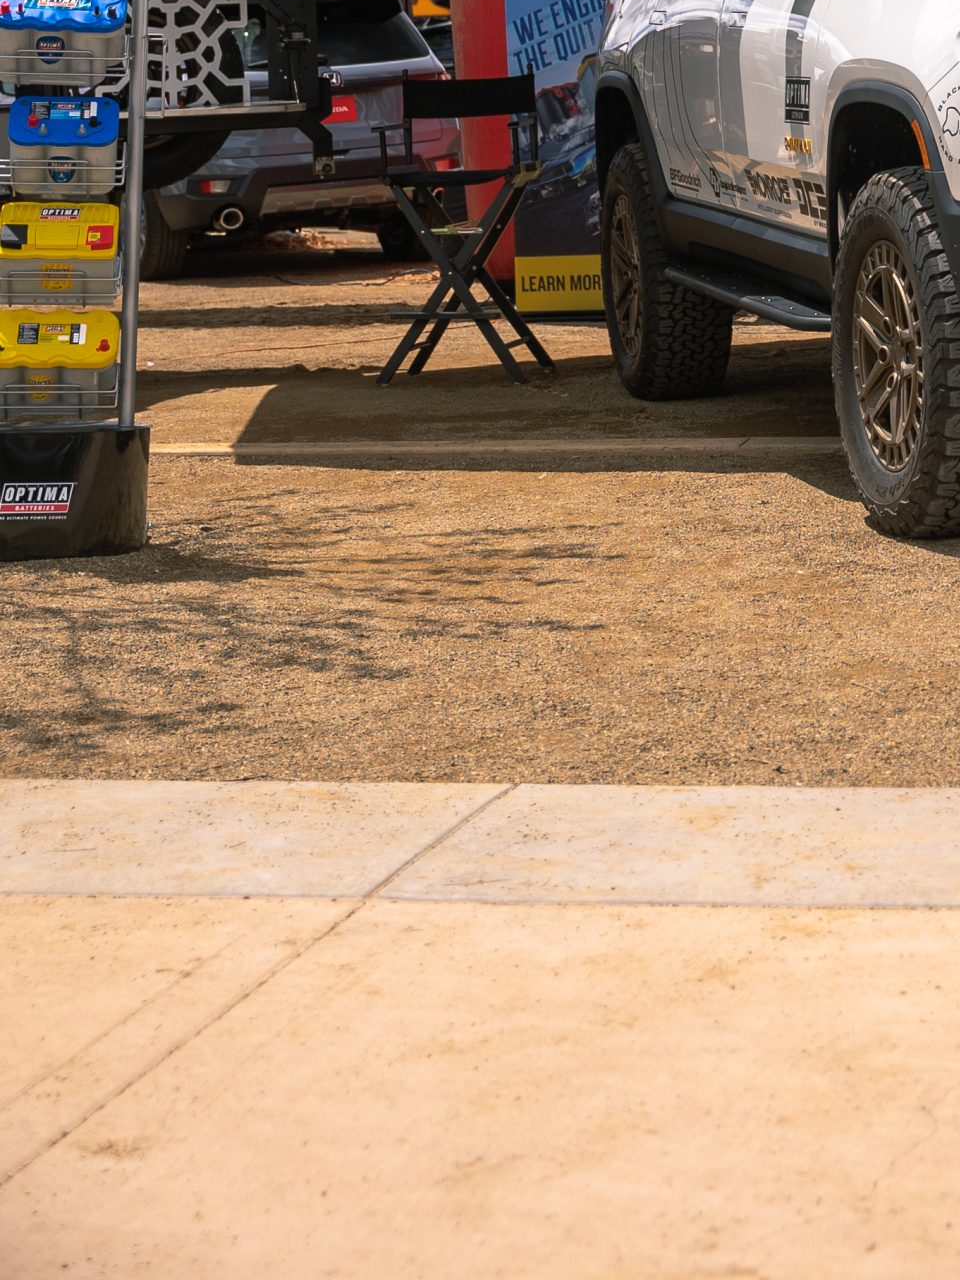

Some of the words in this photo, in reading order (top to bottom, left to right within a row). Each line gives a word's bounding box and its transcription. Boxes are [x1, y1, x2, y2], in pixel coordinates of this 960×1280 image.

[513, 8, 548, 45] WE
[513, 40, 552, 75] THE
[553, 19, 596, 61] QUIT
[938, 135, 953, 162] HARD
[521, 275, 567, 292] LEARN
[570, 274, 601, 291] MOR
[5, 487, 68, 501] OPTIMA
